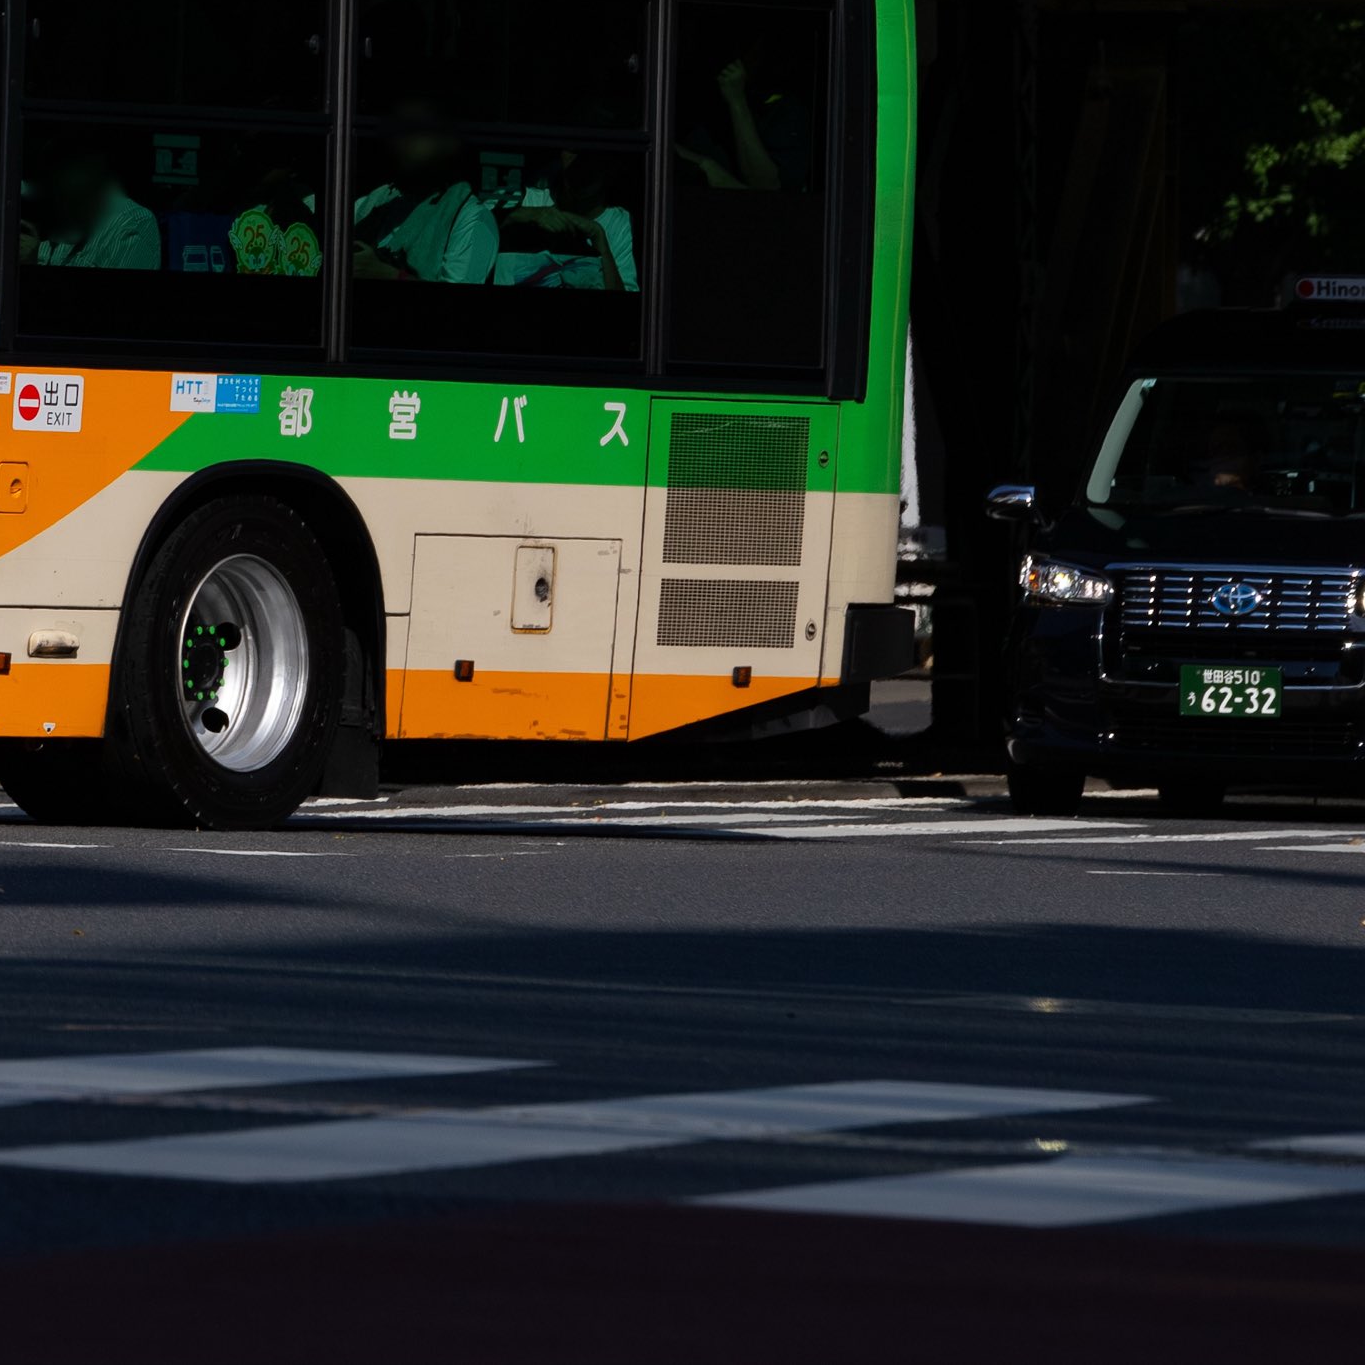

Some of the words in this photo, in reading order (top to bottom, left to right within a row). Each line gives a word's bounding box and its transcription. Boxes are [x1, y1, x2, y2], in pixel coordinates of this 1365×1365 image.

[43, 380, 79, 407] 出口
[176, 380, 203, 395] HTT
[46, 411, 73, 426] EXIT
[279, 386, 629, 447] 都営バス
[1201, 685, 1277, 715] 62-32
